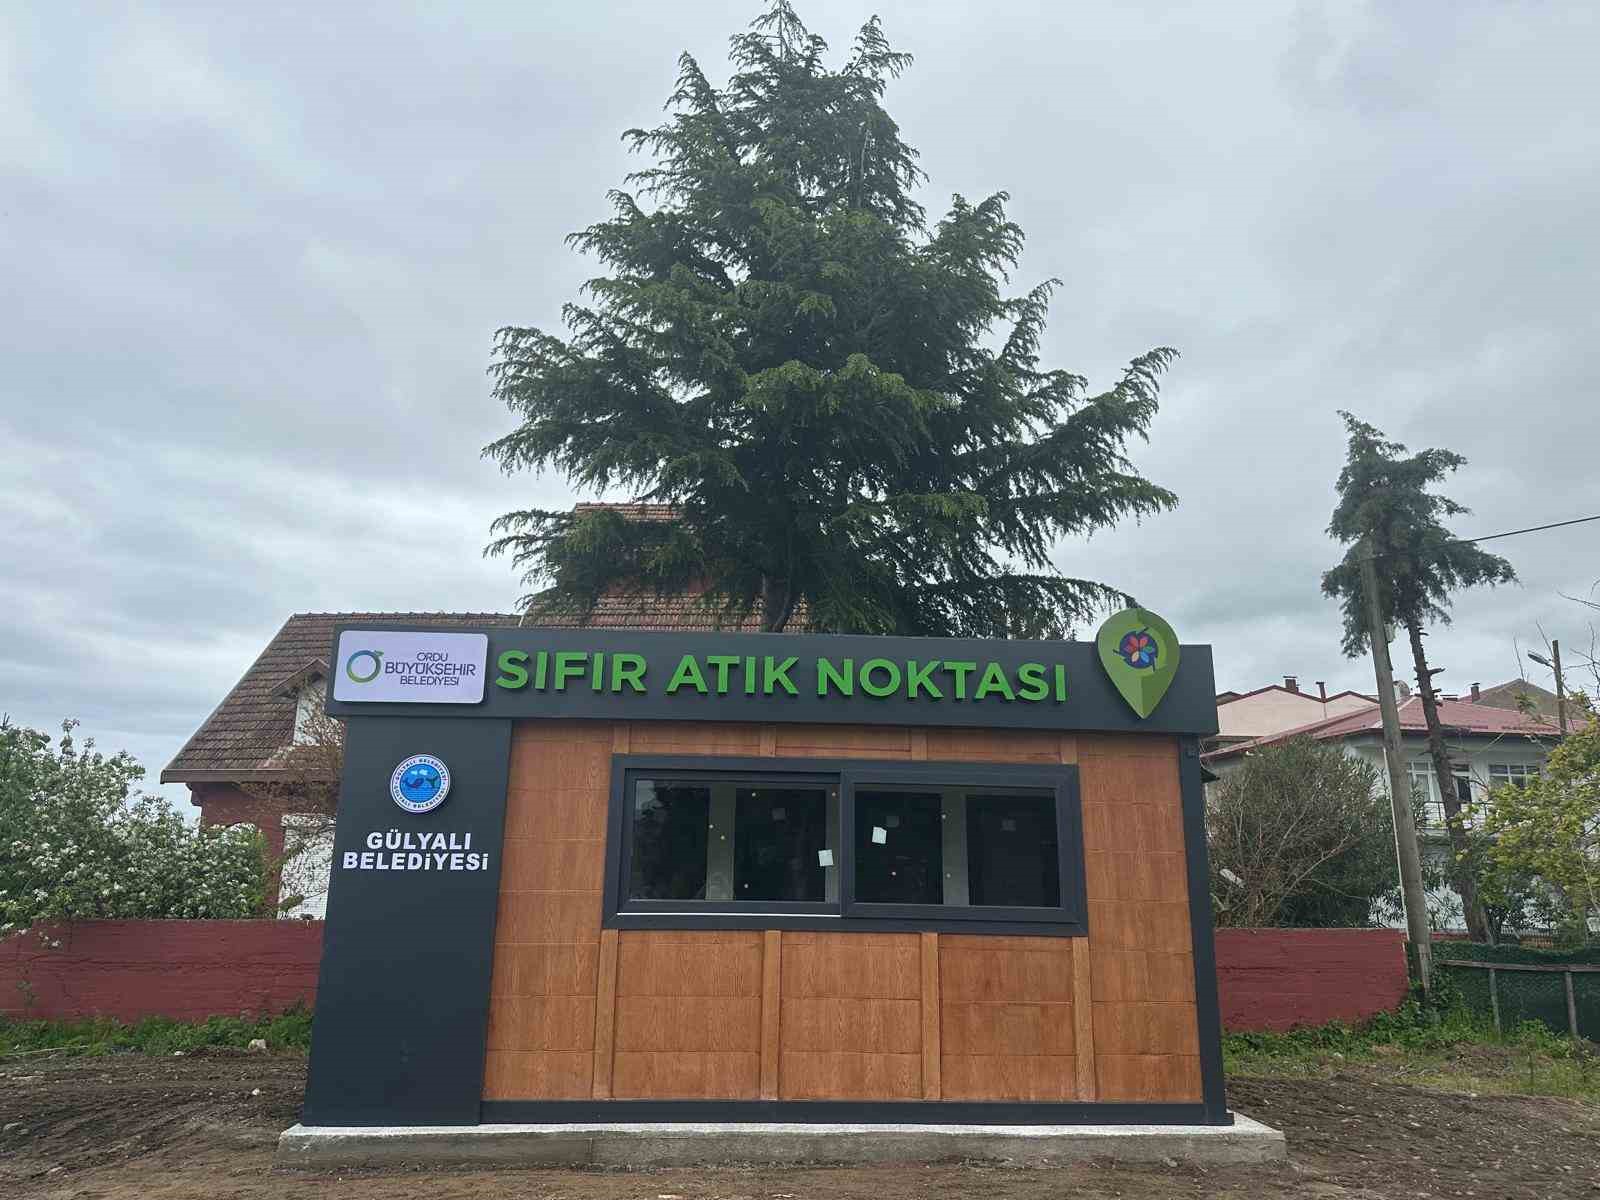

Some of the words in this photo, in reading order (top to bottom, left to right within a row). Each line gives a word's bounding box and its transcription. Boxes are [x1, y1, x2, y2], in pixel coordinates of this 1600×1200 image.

[416, 651, 449, 662] ORDU
[495, 650, 648, 692] SIFIR
[664, 654, 800, 695] ATIK
[816, 657, 1067, 701] NOKTASI
[366, 828, 472, 850] GÜLYALI
